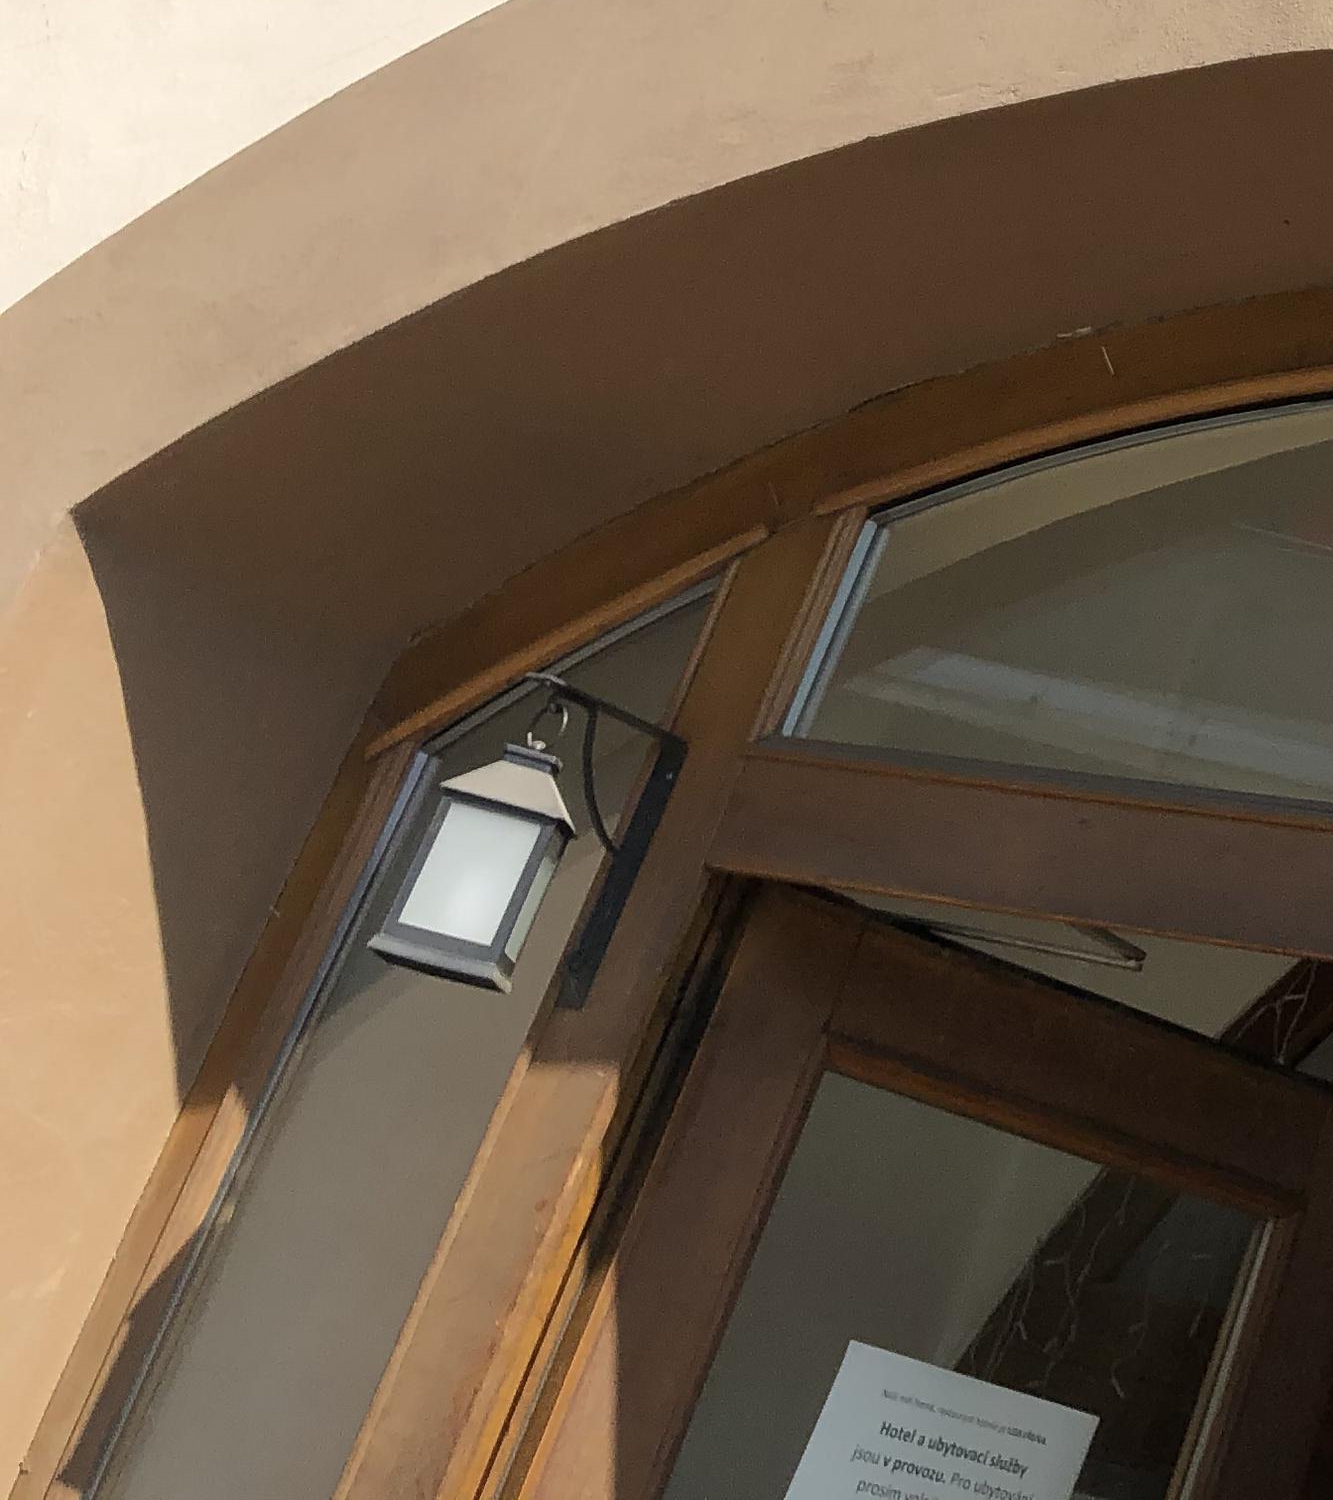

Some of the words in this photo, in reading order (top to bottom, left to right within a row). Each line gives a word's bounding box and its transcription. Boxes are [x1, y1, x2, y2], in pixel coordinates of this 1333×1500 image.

[879, 1420, 917, 1444] Hotel
[917, 1435, 925, 1447] a
[927, 1438, 990, 1465] ubytovací
[850, 1444, 880, 1463] jsou
[882, 1454, 890, 1468] v
[892, 1455, 946, 1484] provozu.
[951, 1472, 971, 1491] Pro
